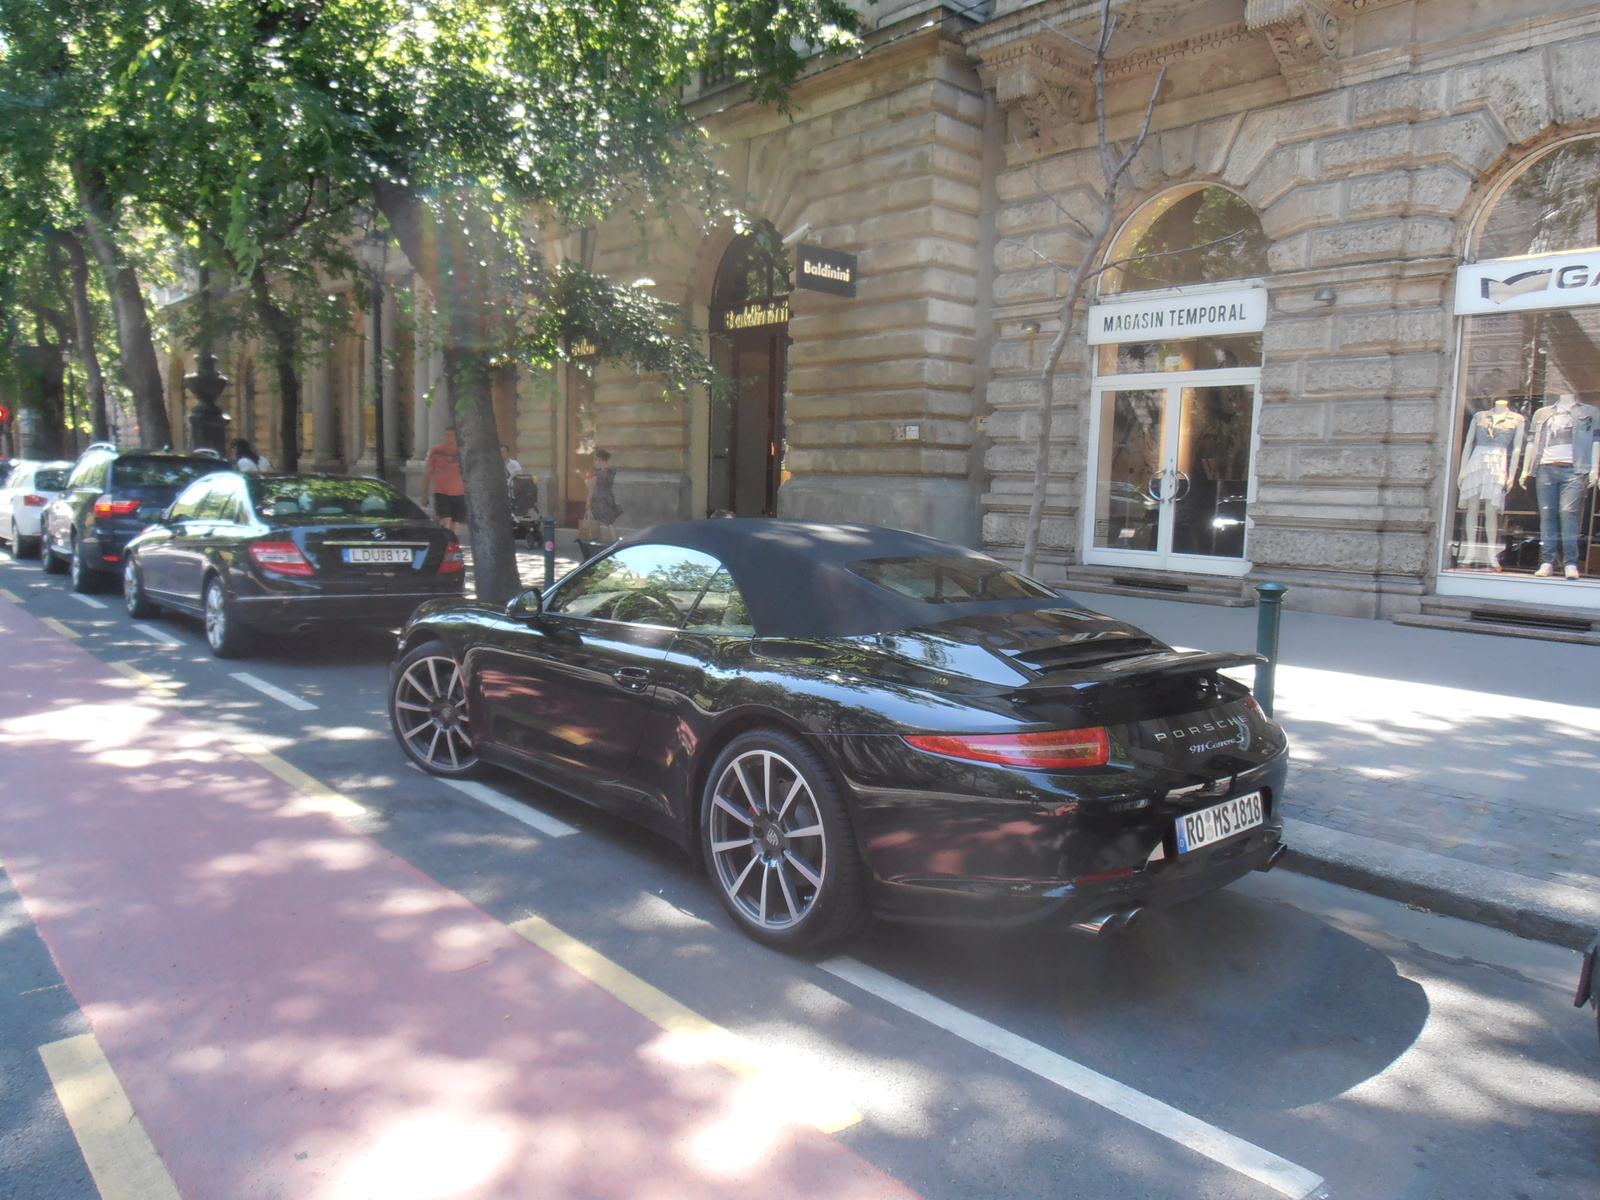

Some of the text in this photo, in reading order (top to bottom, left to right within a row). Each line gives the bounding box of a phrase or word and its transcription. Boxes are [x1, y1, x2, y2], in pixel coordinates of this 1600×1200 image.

[803, 260, 850, 283] Baldinini
[1103, 303, 1247, 333] MAGASIN TEMPORAL
[352, 549, 409, 562] LDU 812
[1154, 715, 1247, 742] PORSCHE
[1189, 743, 1205, 754] 911
[1185, 795, 1261, 847] RO MS 1818
